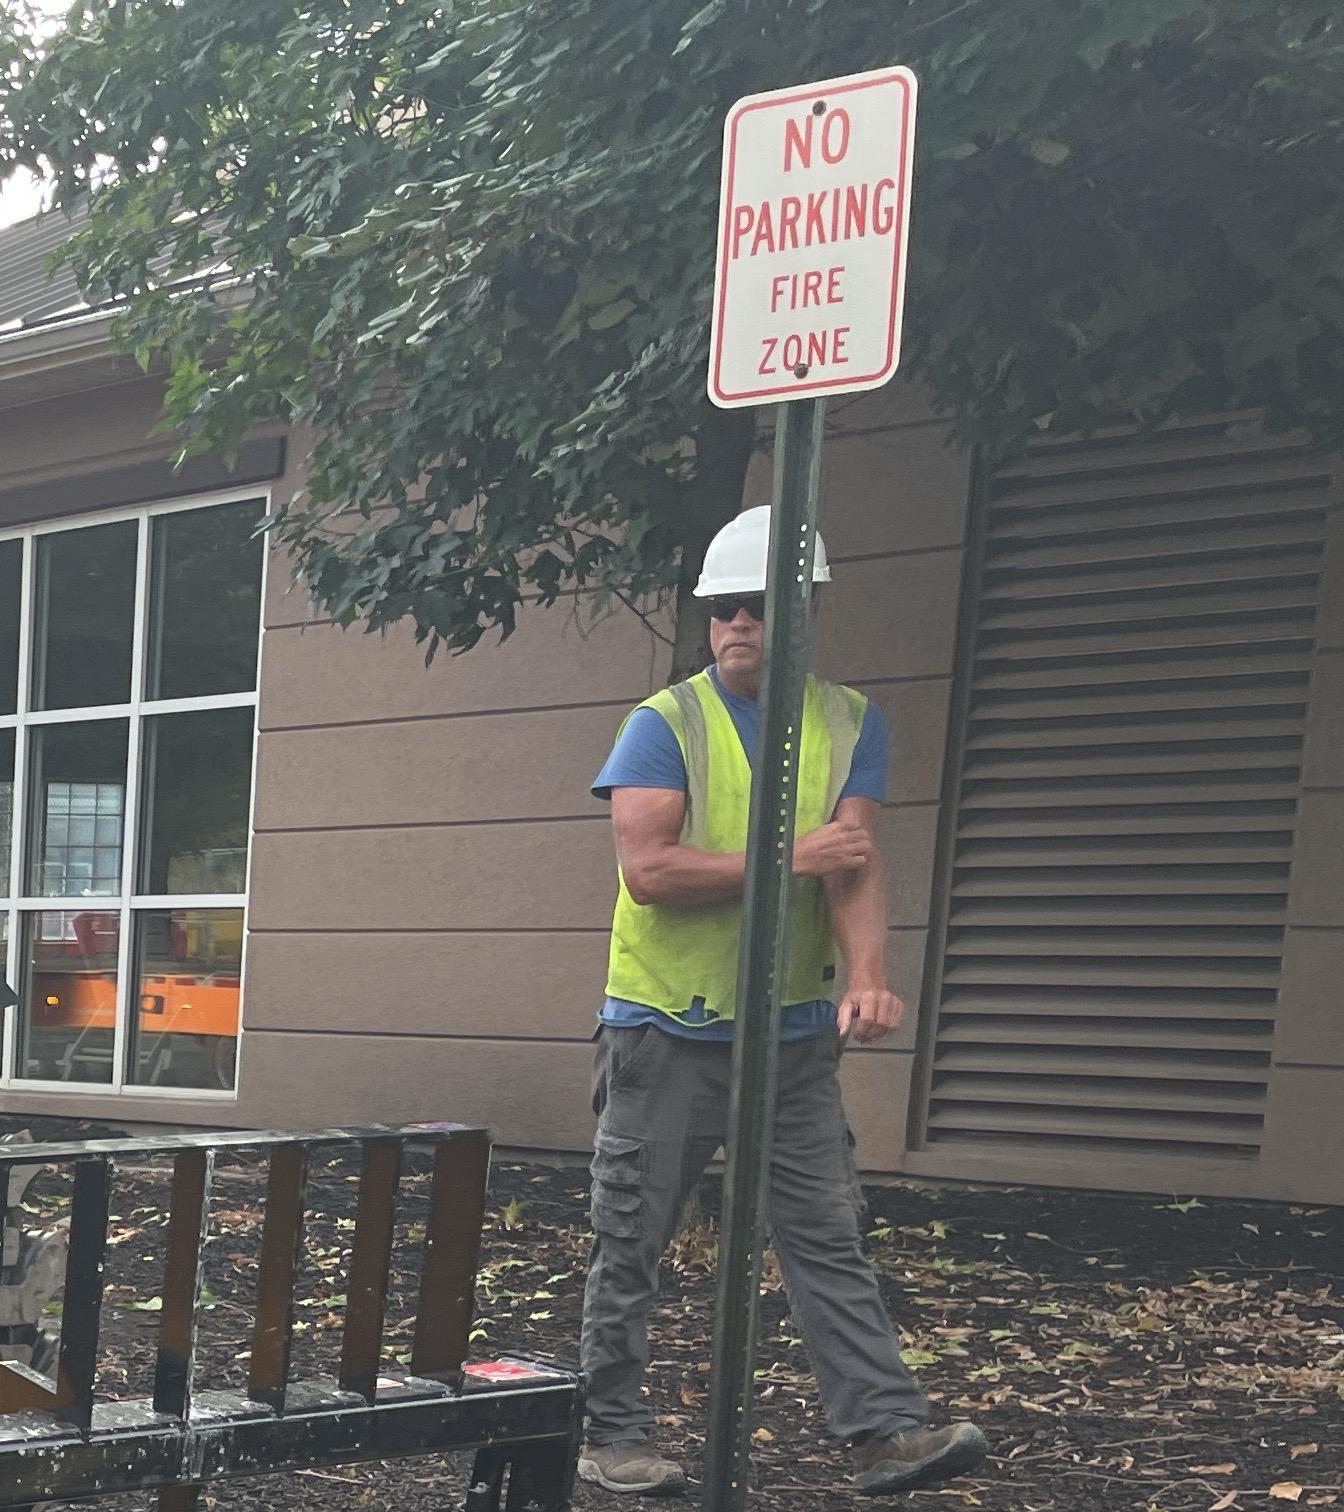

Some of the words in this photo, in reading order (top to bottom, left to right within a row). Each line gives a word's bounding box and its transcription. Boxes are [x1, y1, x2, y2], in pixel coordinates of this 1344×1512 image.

[783, 107, 851, 172] NO
[732, 177, 896, 259] PARKING
[770, 265, 846, 313] FIRE
[758, 326, 851, 375] ZONE
